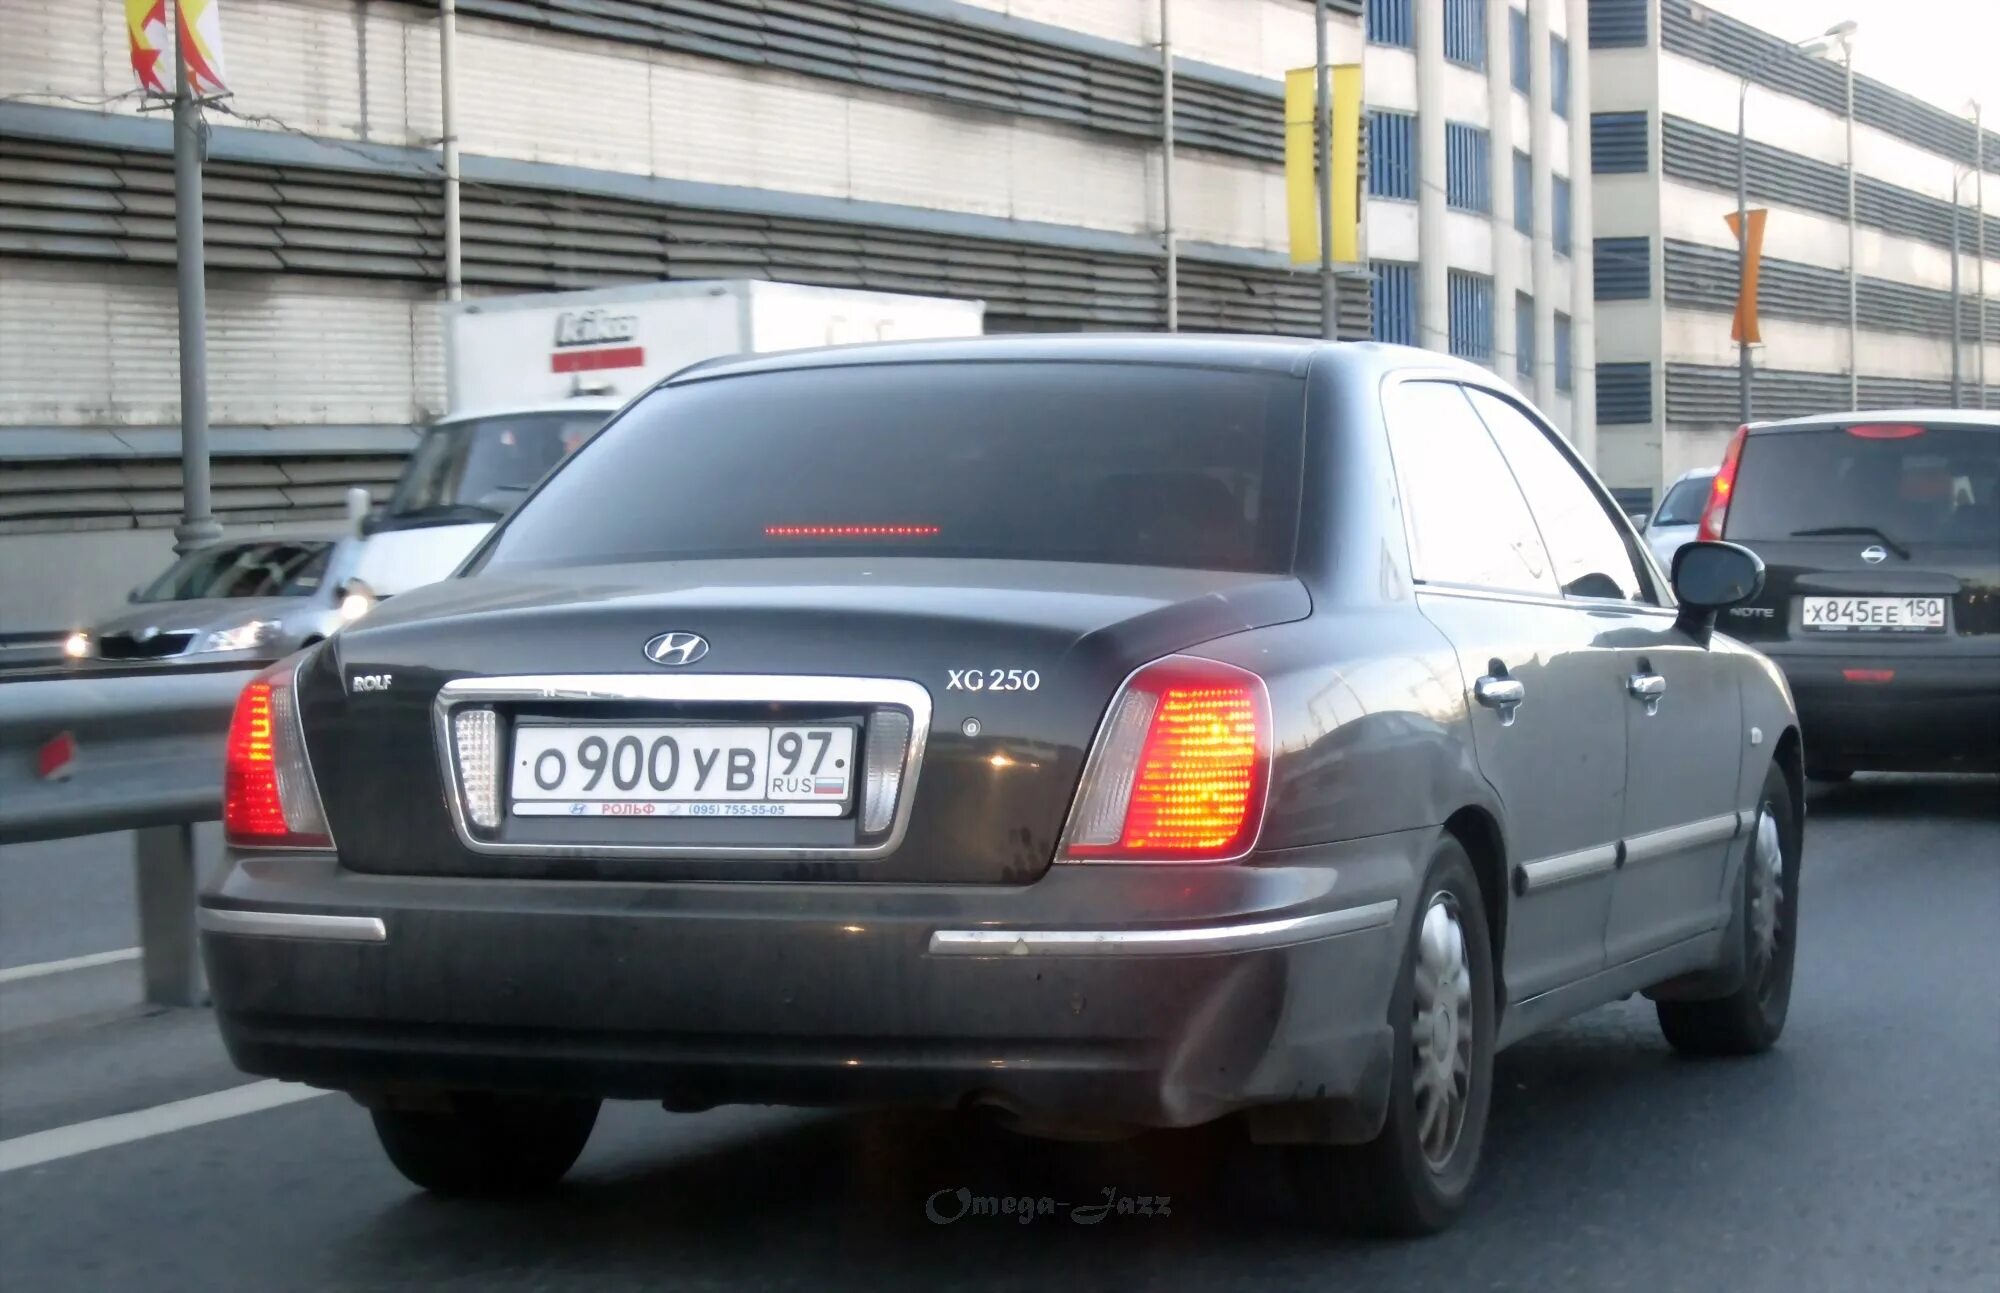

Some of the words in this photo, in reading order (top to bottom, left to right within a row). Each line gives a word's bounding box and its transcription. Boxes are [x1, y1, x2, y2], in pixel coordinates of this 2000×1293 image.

[1905, 599, 1938, 617] 150
[353, 674, 392, 692] ROLF
[945, 669, 984, 691] XG
[988, 669, 1040, 691] 250
[777, 731, 832, 775] 97
[772, 778, 812, 793] RUS
[601, 803, 656, 815] РОЛЬФ
[688, 804, 720, 815] (095)
[724, 804, 785, 815] 755-55-05
